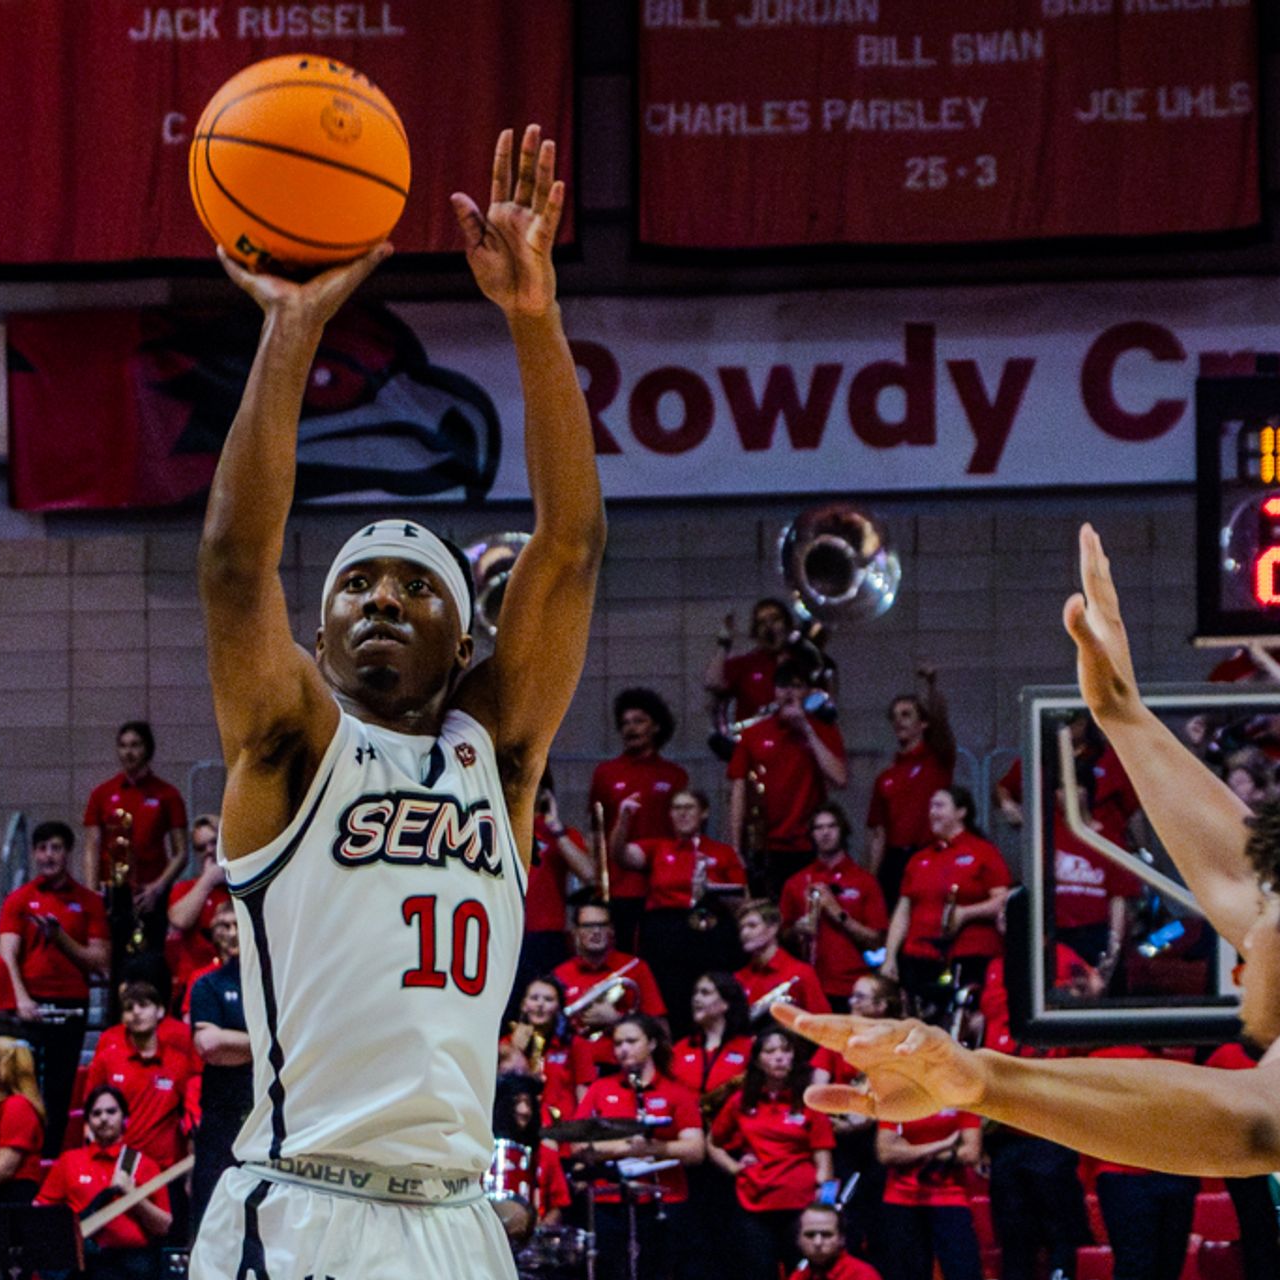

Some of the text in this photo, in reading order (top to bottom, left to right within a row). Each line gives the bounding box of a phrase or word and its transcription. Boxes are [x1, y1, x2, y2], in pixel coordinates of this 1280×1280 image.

[128, 2, 407, 41] JACK RUSSELL
[856, 29, 1044, 68] BILL SWAN
[645, 97, 990, 135] CHARLES PARSLEY
[1074, 86, 1148, 123] JOE
[568, 321, 1037, 476] Rowdy
[402, 895, 491, 997] 10
[270, 1156, 470, 1197] UNER ARMO
